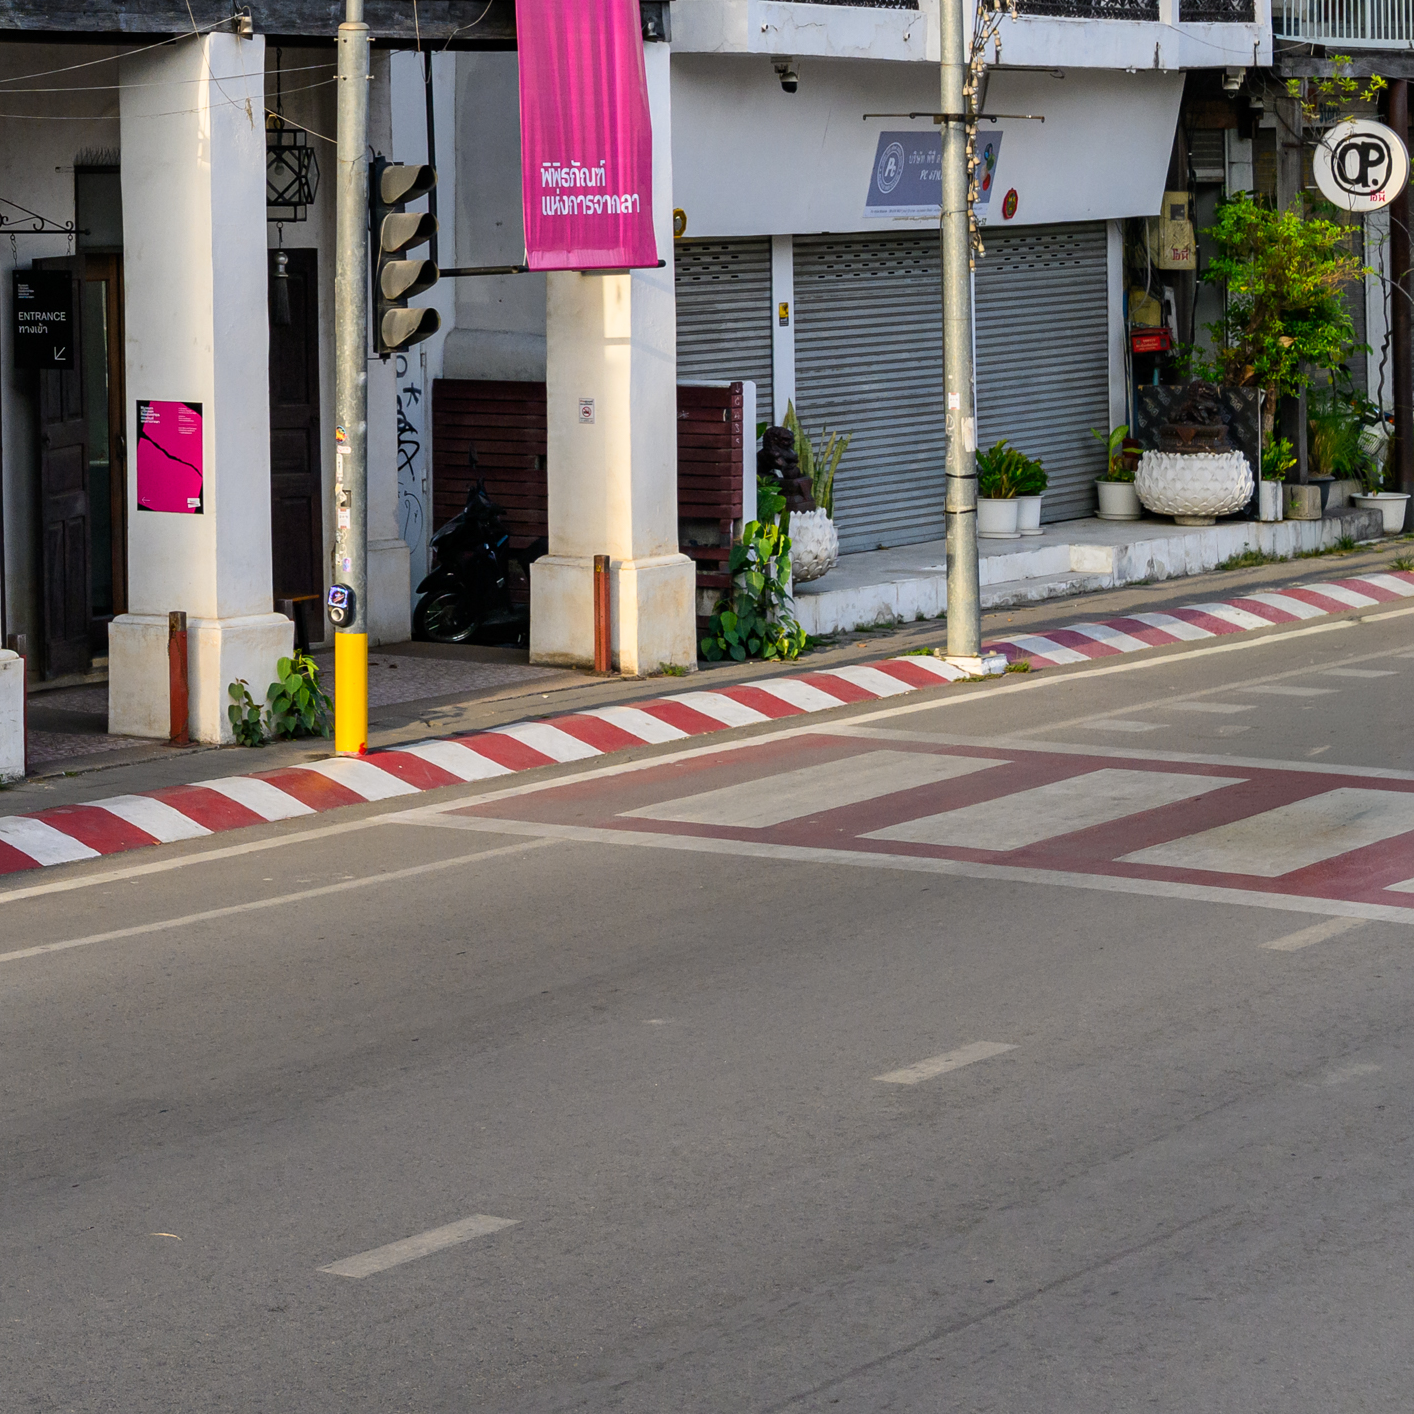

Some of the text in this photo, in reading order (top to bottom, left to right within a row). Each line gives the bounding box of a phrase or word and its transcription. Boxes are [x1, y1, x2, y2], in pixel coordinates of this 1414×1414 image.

[540, 159, 606, 188] พิพิธภัณฑ์
[541, 187, 640, 216] แห่งการจากลา
[18, 311, 66, 321] ENTRANCE
[18, 322, 48, 334] ทางเข้า
